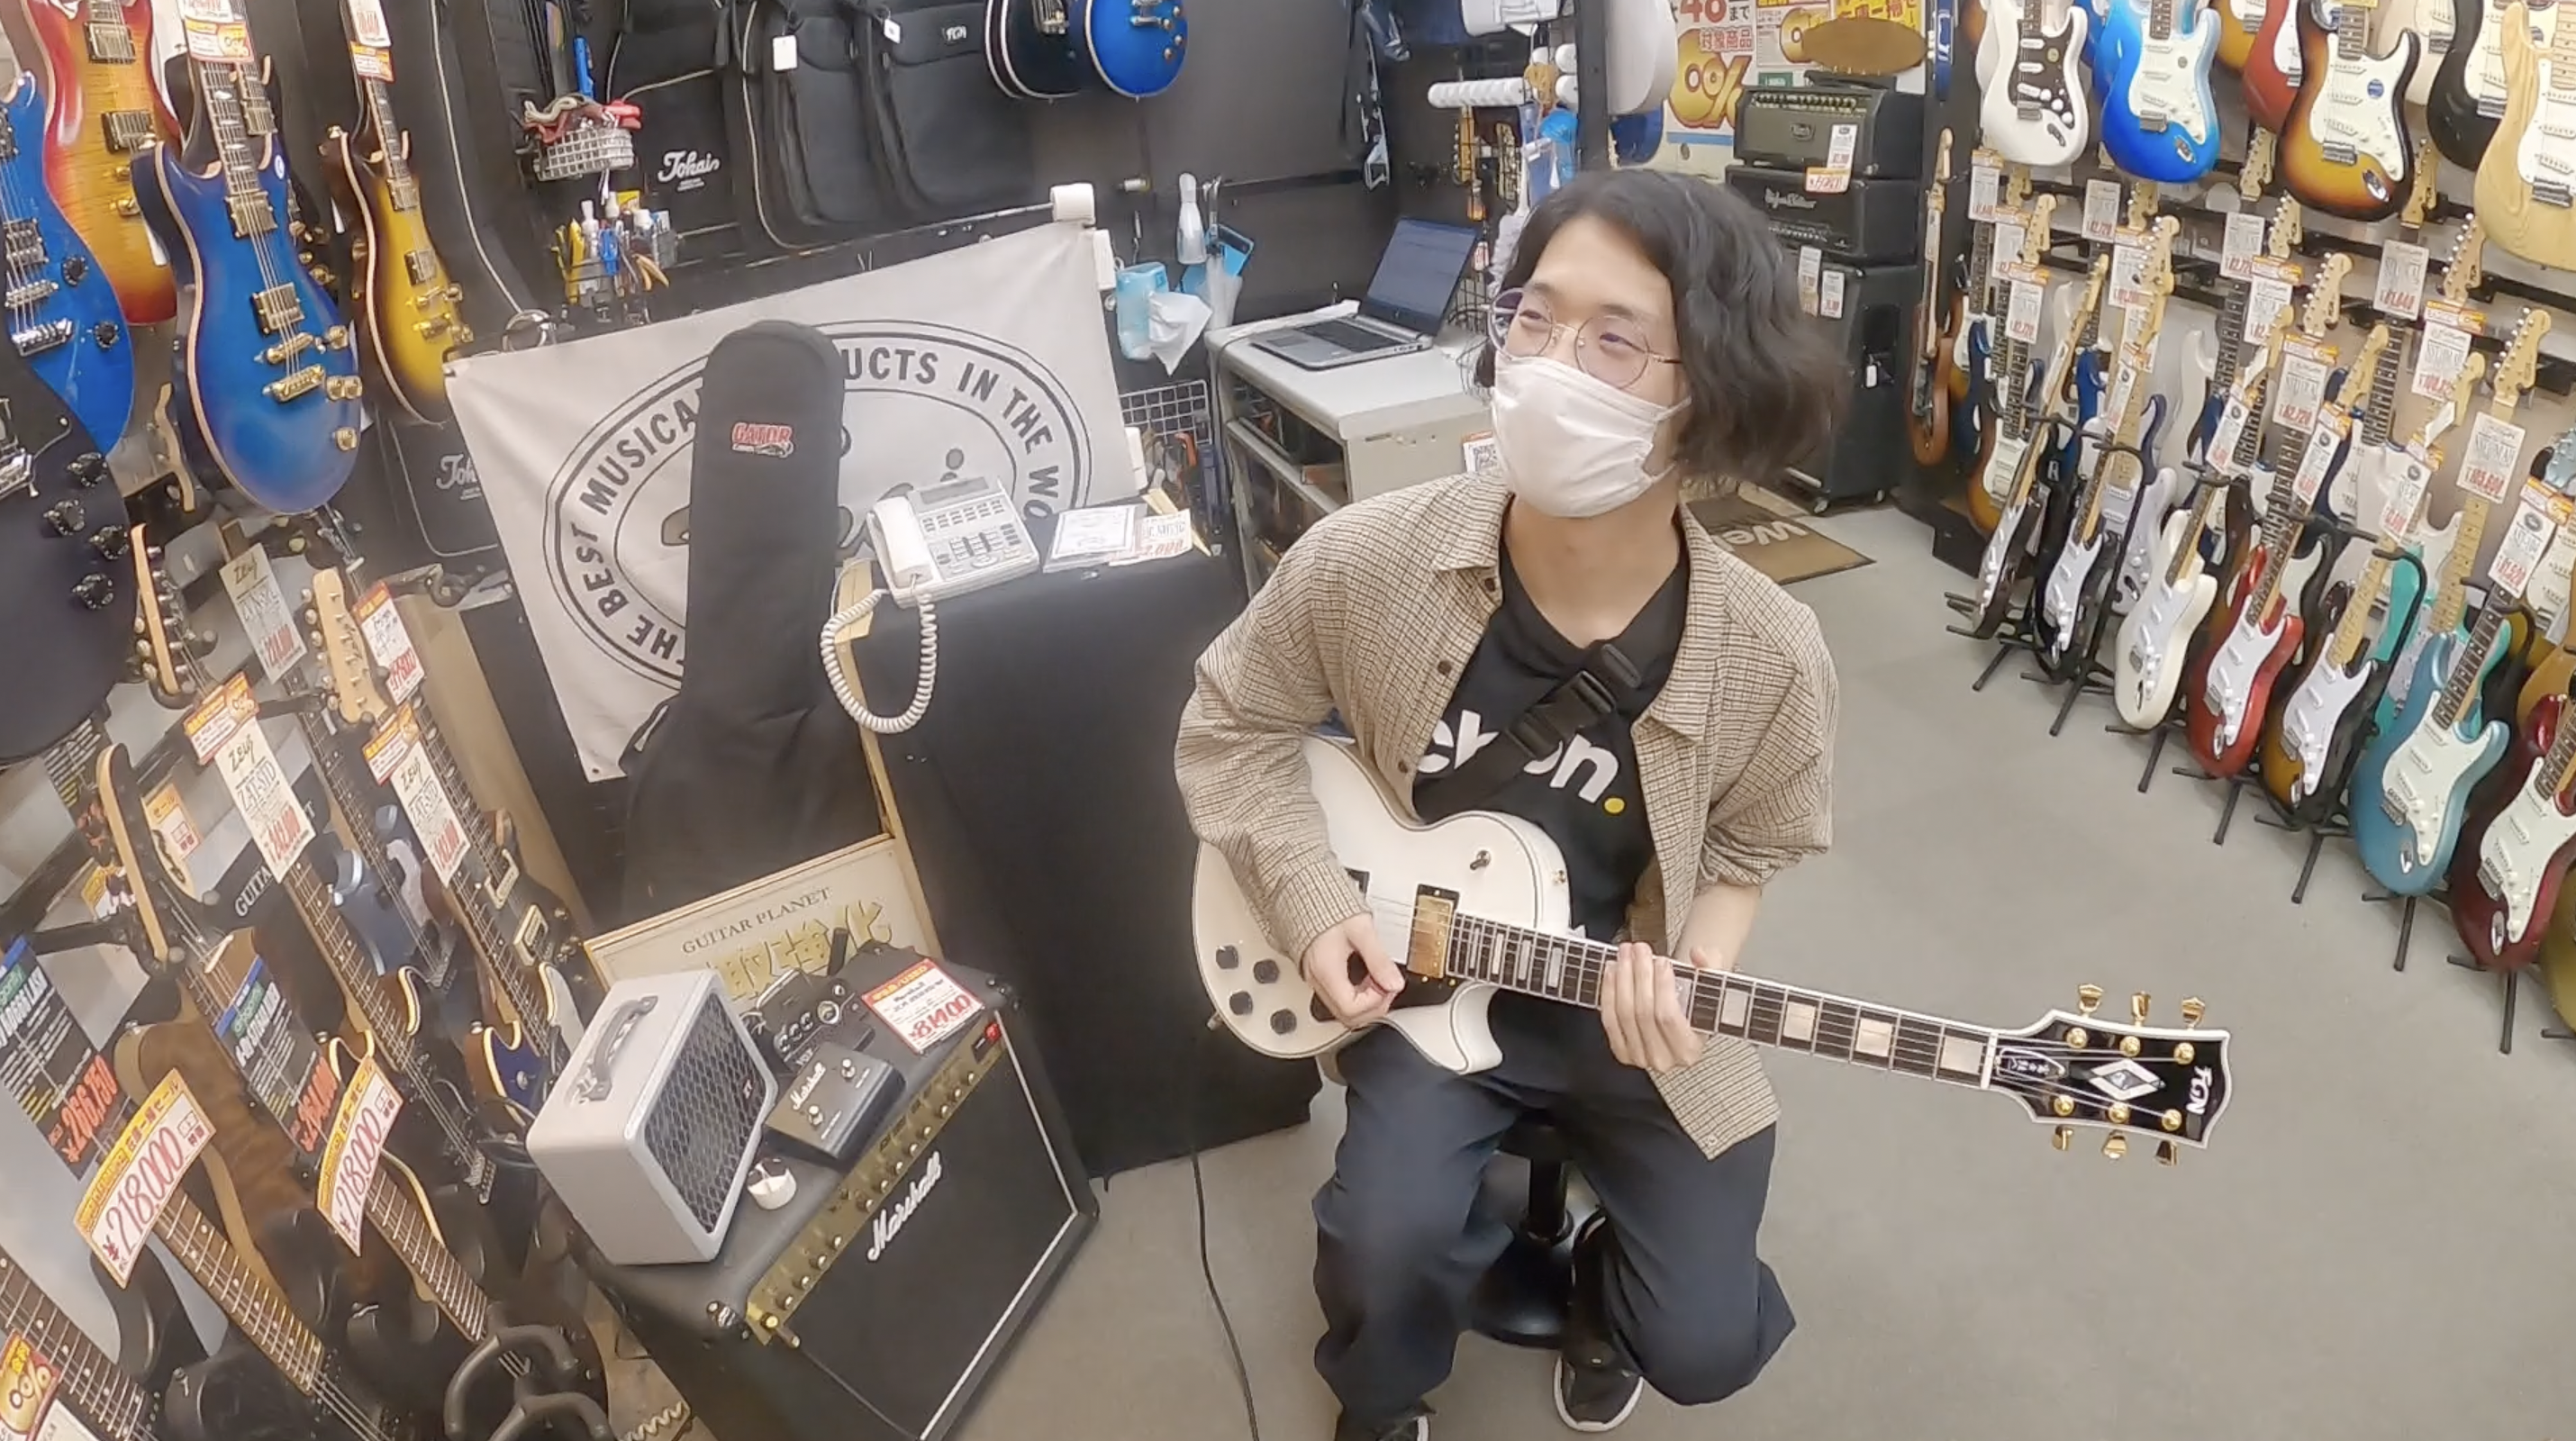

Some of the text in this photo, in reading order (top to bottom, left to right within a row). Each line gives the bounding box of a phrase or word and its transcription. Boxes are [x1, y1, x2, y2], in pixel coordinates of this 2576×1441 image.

[658, 150, 720, 182] Tokai
[957, 362, 1000, 403] IN
[1002, 387, 1054, 455] THE
[580, 399, 698, 515] MUSICA
[570, 521, 630, 618] BEST
[627, 614, 685, 666] HE
[234, 865, 273, 917] GUITA
[682, 885, 833, 955] GUITAR PLANET
[866, 1150, 943, 1262] Marshall
